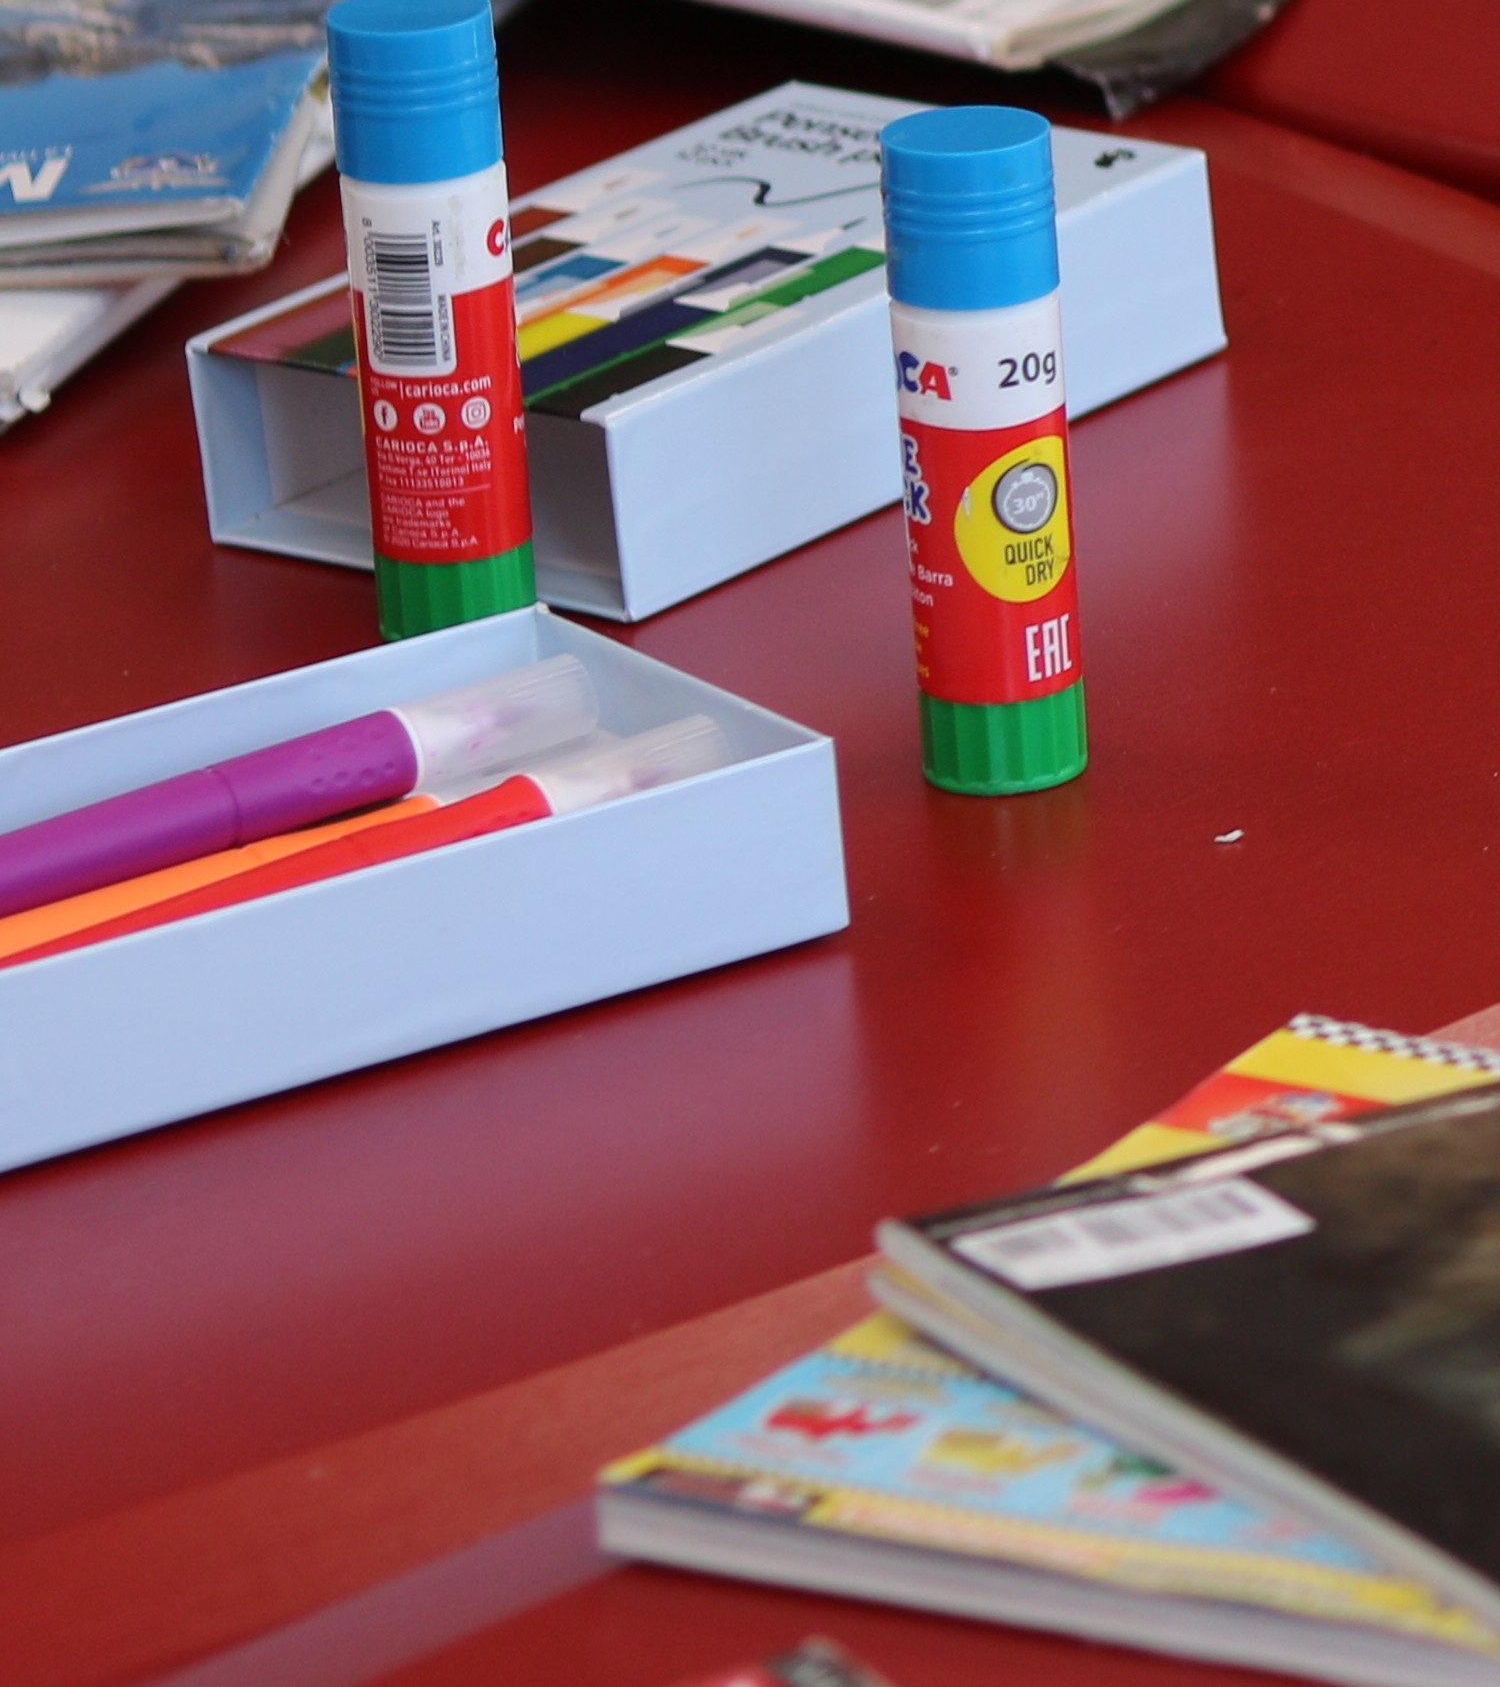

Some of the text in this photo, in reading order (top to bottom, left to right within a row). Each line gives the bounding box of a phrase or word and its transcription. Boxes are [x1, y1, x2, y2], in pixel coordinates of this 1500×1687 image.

[440, 333, 451, 361] CHINA
[998, 350, 1057, 390] 20g
[406, 376, 491, 398] carioca.com
[376, 436, 437, 453] CARIOCA
[1004, 533, 1054, 565] QUICK
[918, 565, 953, 587] Barra
[1026, 558, 1055, 586] DRY
